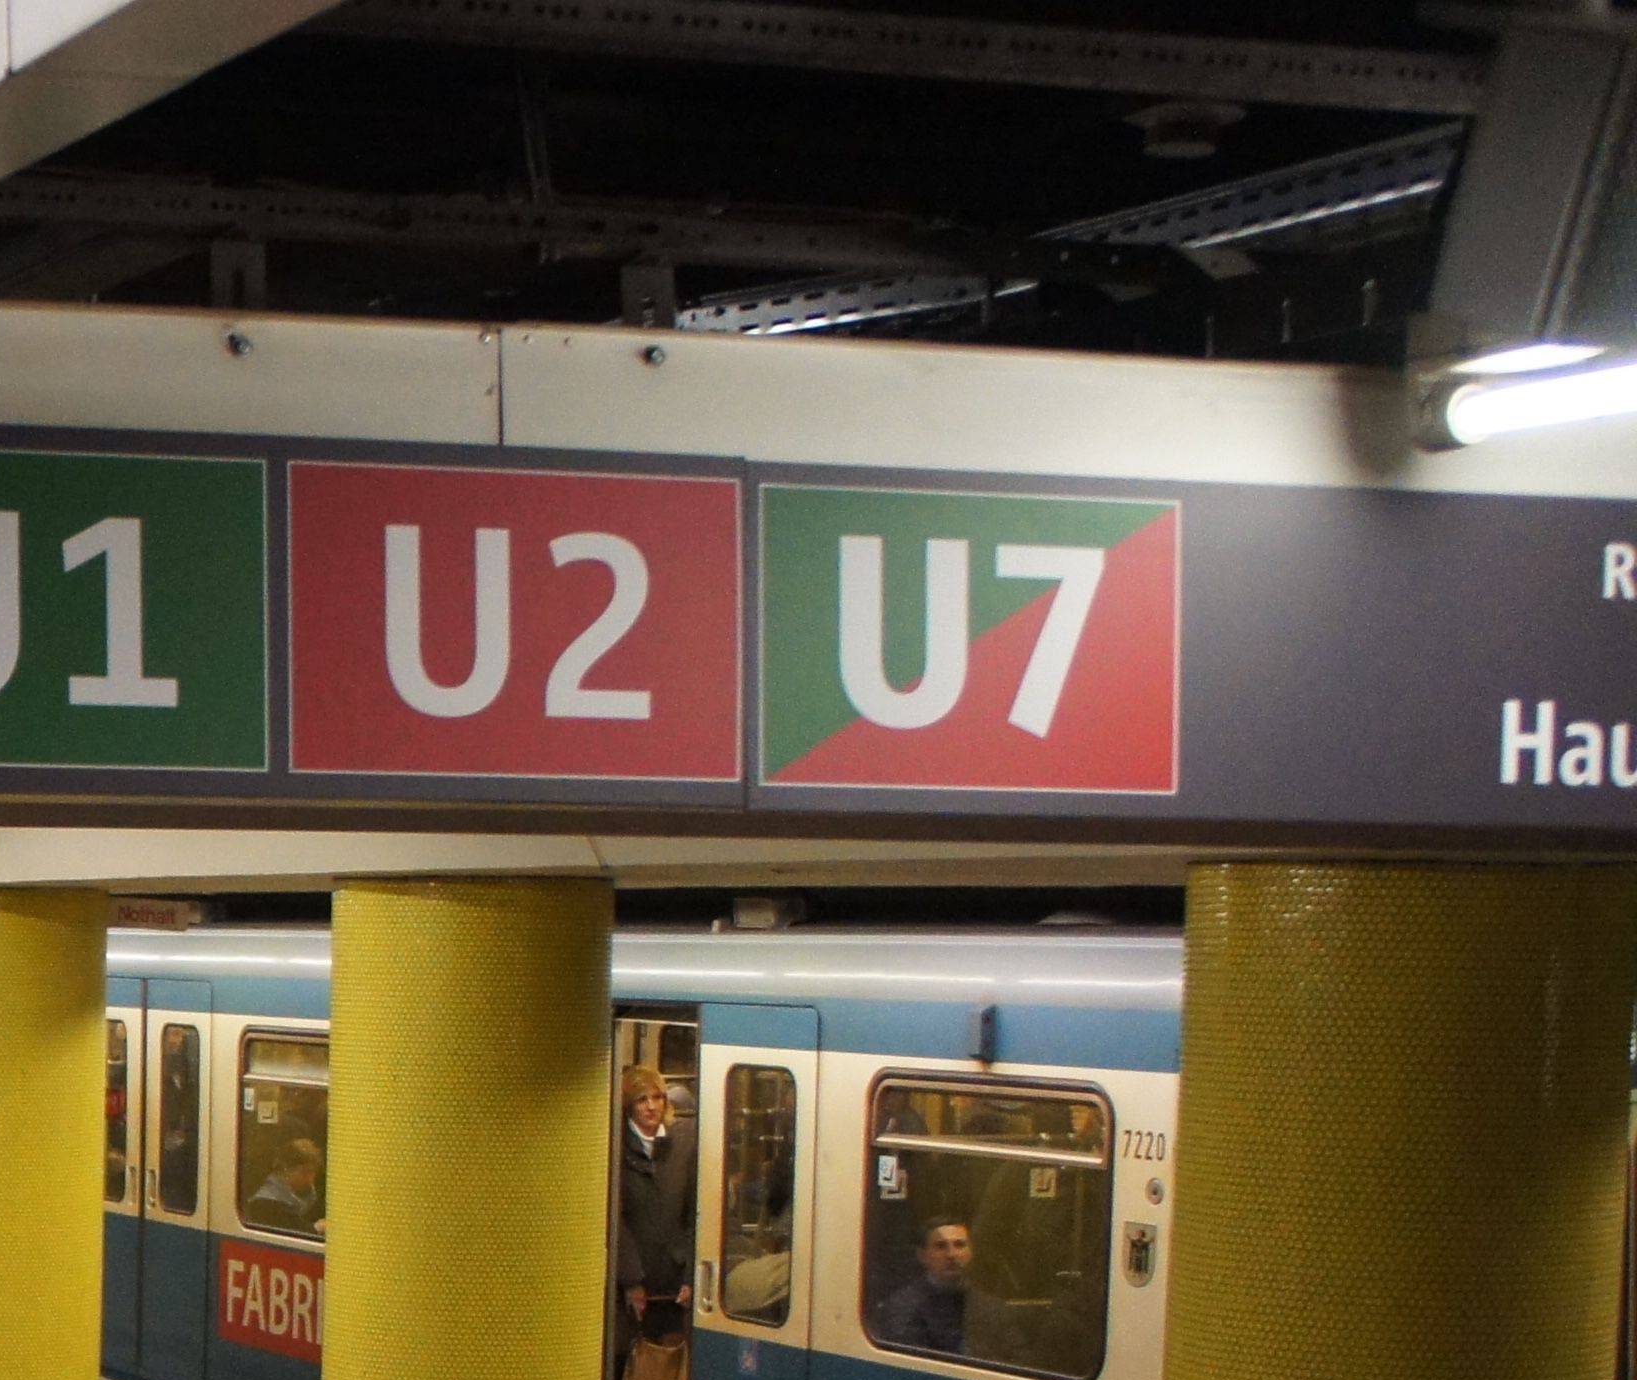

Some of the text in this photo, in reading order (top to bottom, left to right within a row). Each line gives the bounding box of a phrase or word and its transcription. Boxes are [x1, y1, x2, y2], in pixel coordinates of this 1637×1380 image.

[385, 524, 652, 721] U2
[838, 535, 1107, 738] U7
[117, 904, 175, 924] Nothalt
[1123, 1129, 1165, 1161] 7220
[226, 1258, 324, 1346] FABRI
